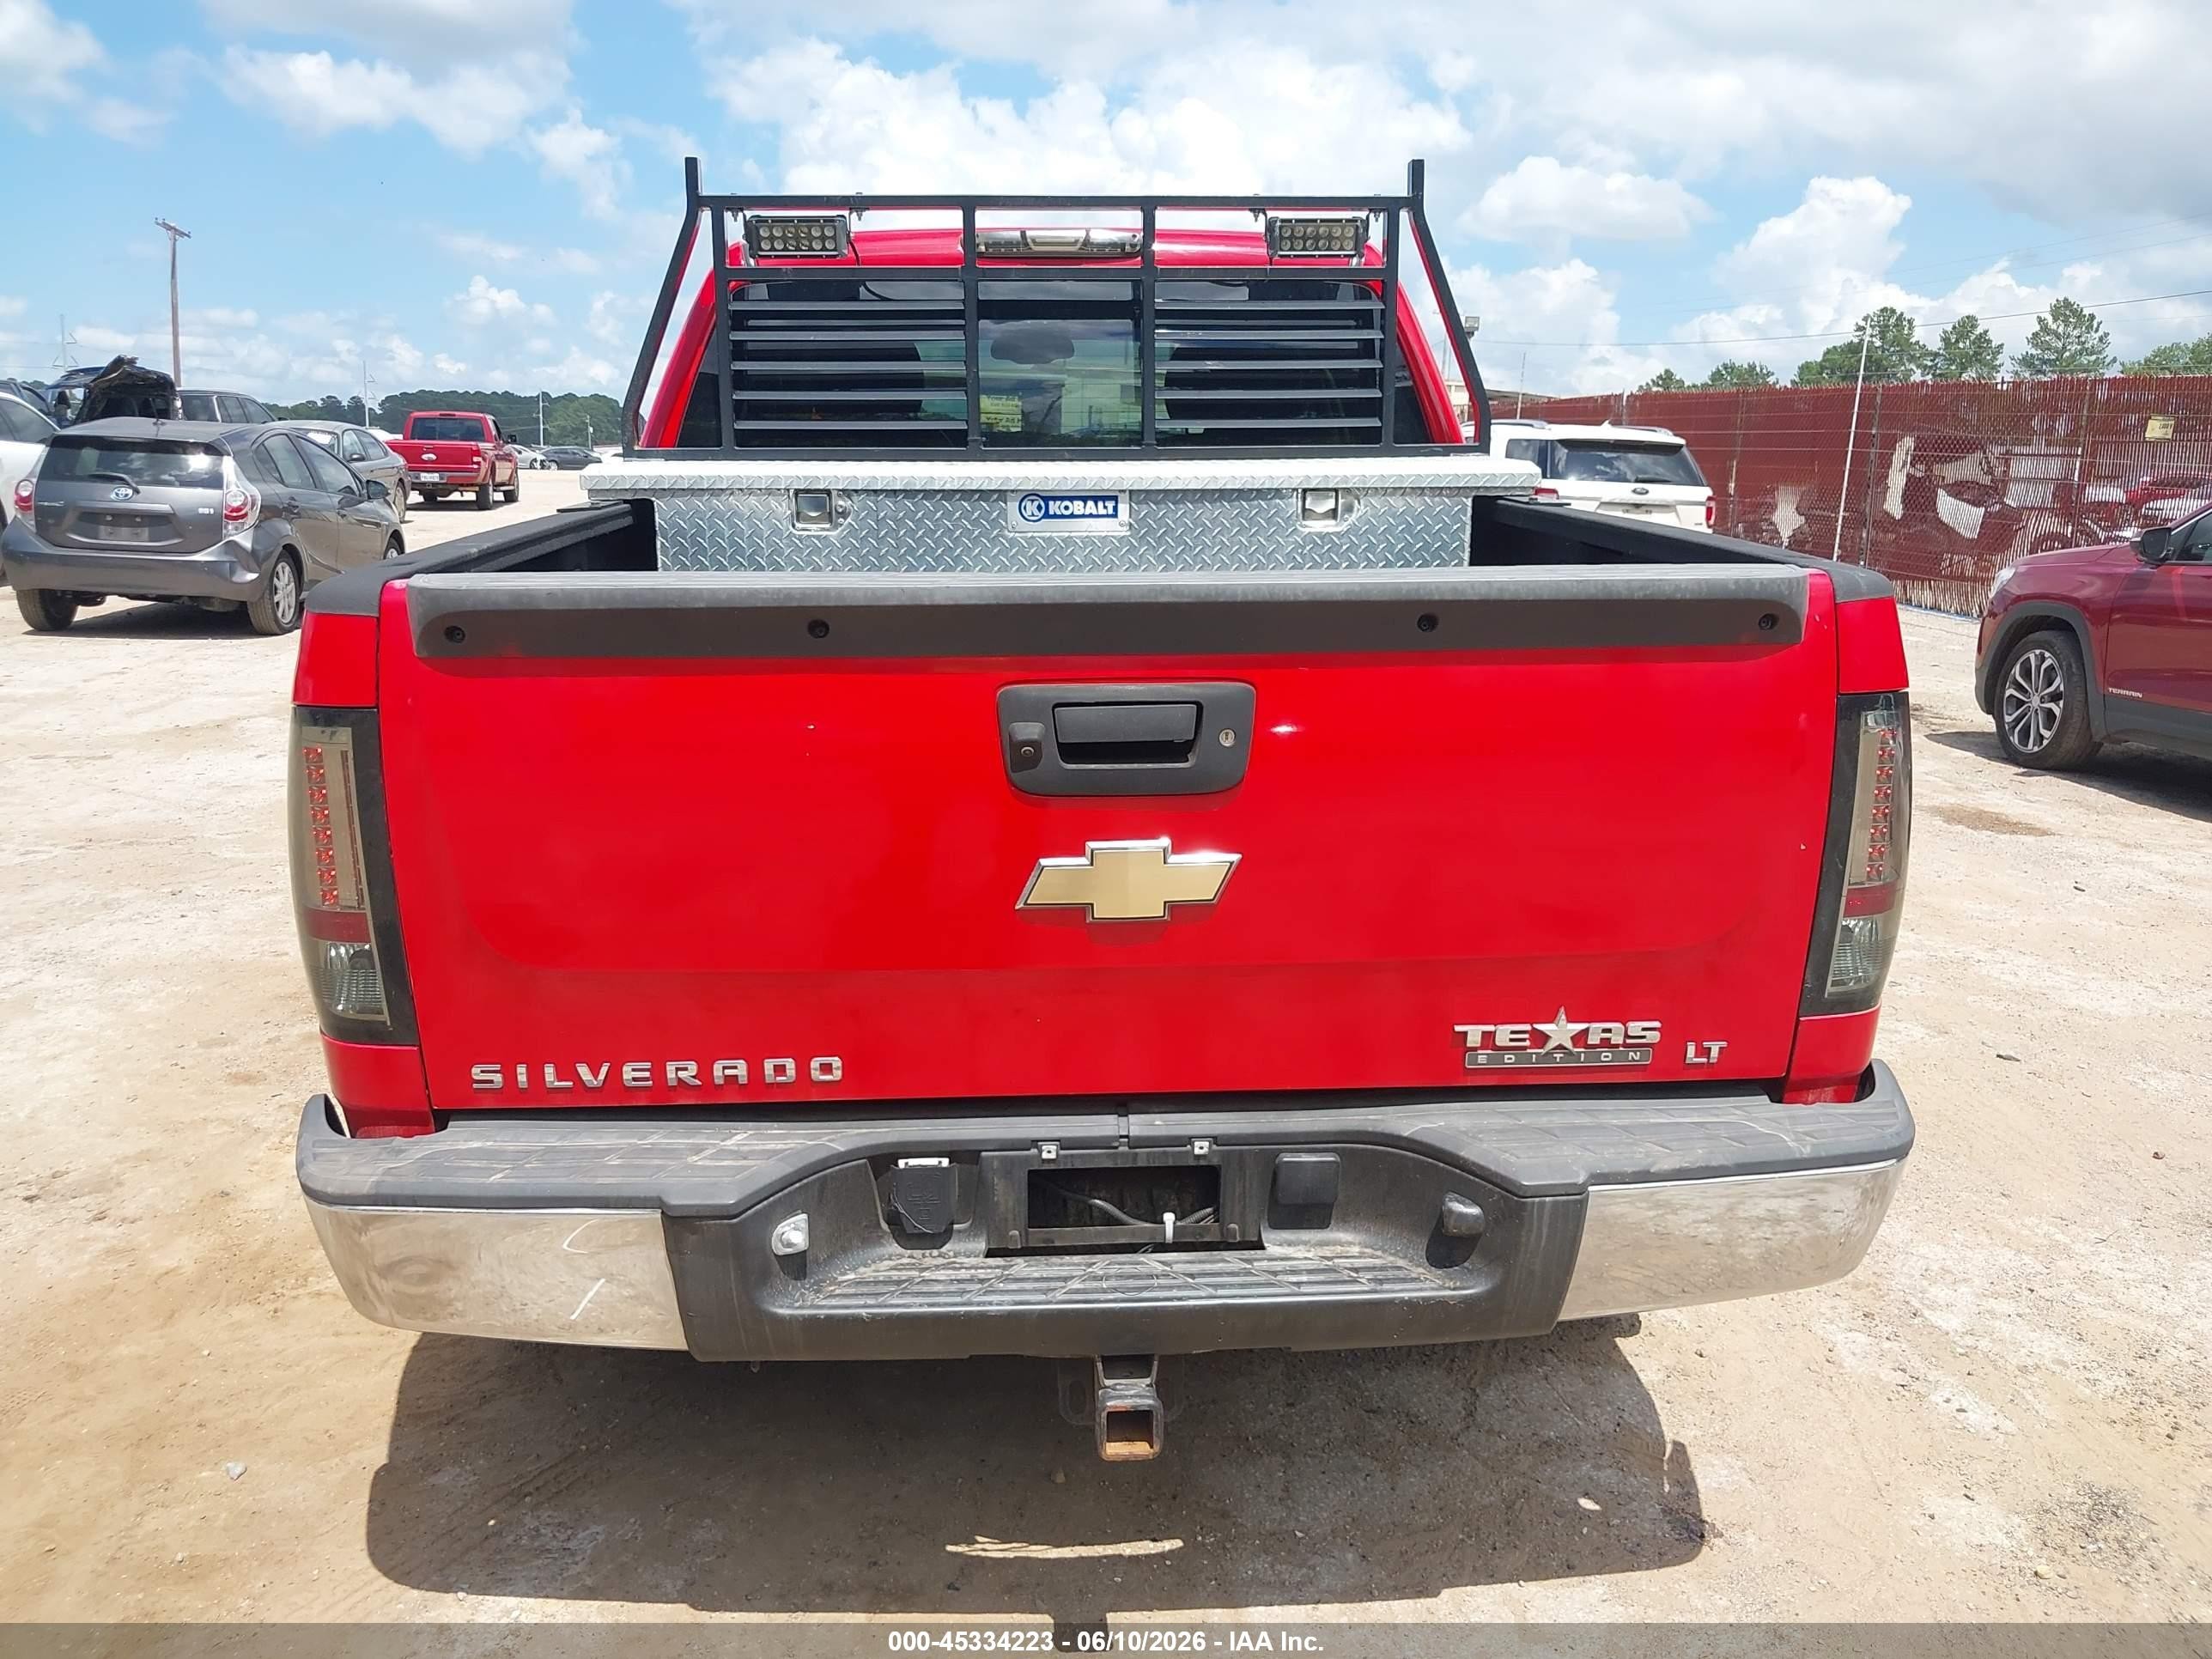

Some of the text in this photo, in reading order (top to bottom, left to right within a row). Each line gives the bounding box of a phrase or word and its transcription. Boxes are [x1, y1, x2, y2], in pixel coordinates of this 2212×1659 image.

[1048, 501, 1115, 515] KOBALT
[1454, 1006, 1662, 1052] TEXAS
[1477, 1051, 1641, 1064] EDITION
[1686, 1041, 1729, 1064] LT
[471, 1056, 843, 1089] SILVERADO
